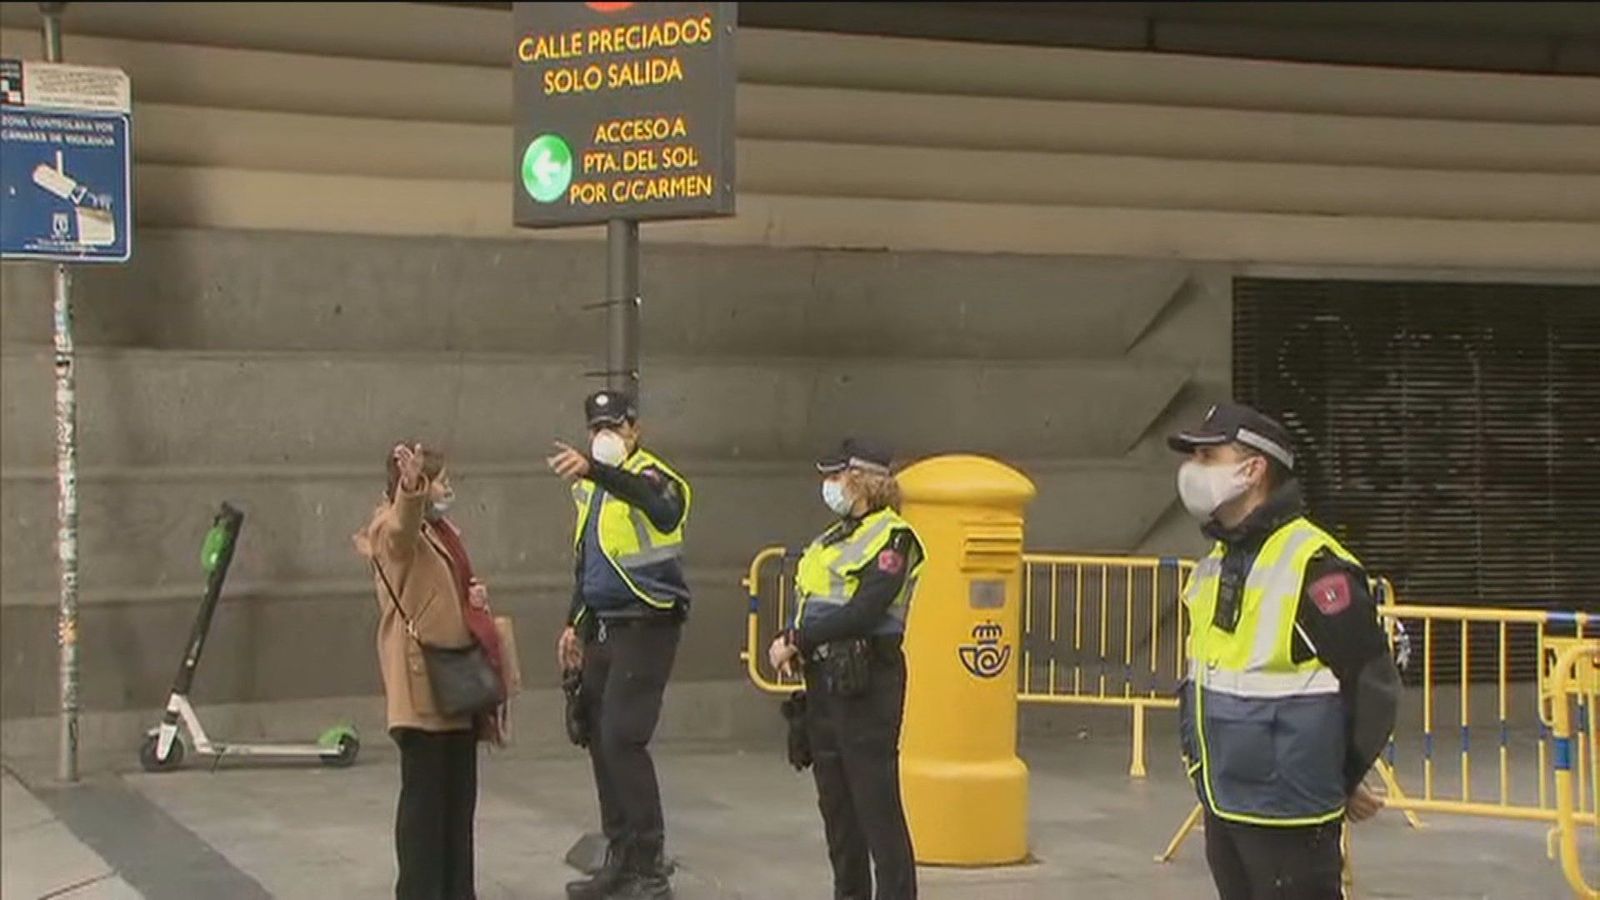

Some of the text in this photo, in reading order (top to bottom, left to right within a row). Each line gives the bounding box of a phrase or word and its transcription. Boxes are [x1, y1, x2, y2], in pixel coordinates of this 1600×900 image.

[517, 16, 713, 62] CALLE PRECIADOS
[543, 56, 684, 95] SOLO SALIDA
[593, 116, 688, 144] ACCESO A
[582, 145, 699, 174] PTA. DEL SOL
[569, 174, 714, 205] POR C/CARMEN
